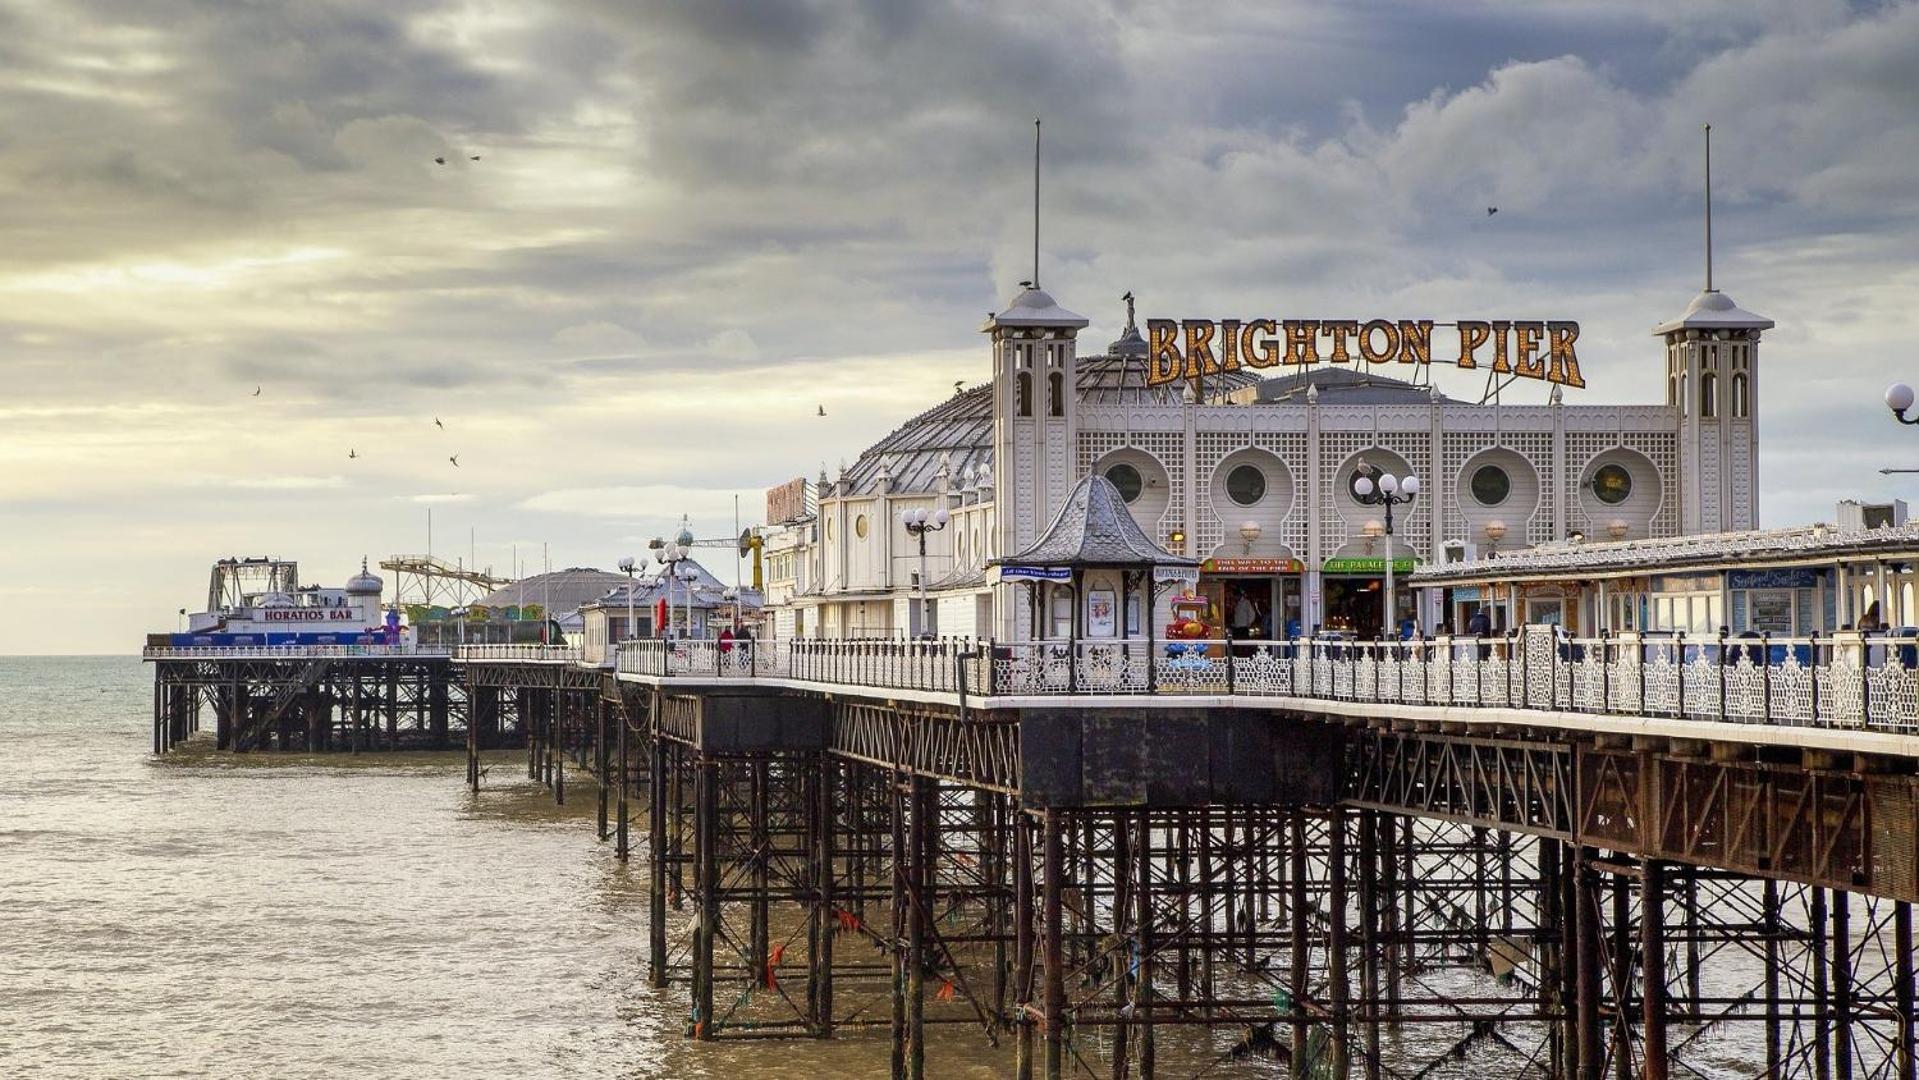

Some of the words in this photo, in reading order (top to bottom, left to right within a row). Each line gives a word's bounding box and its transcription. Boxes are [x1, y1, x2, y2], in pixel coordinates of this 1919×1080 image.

[1147, 318, 1434, 387] BRIGHTON
[1457, 320, 1586, 389] PIER
[1350, 561, 1384, 569] PALACE
[264, 611, 324, 620] HORATIOS
[329, 610, 353, 620] BAR
